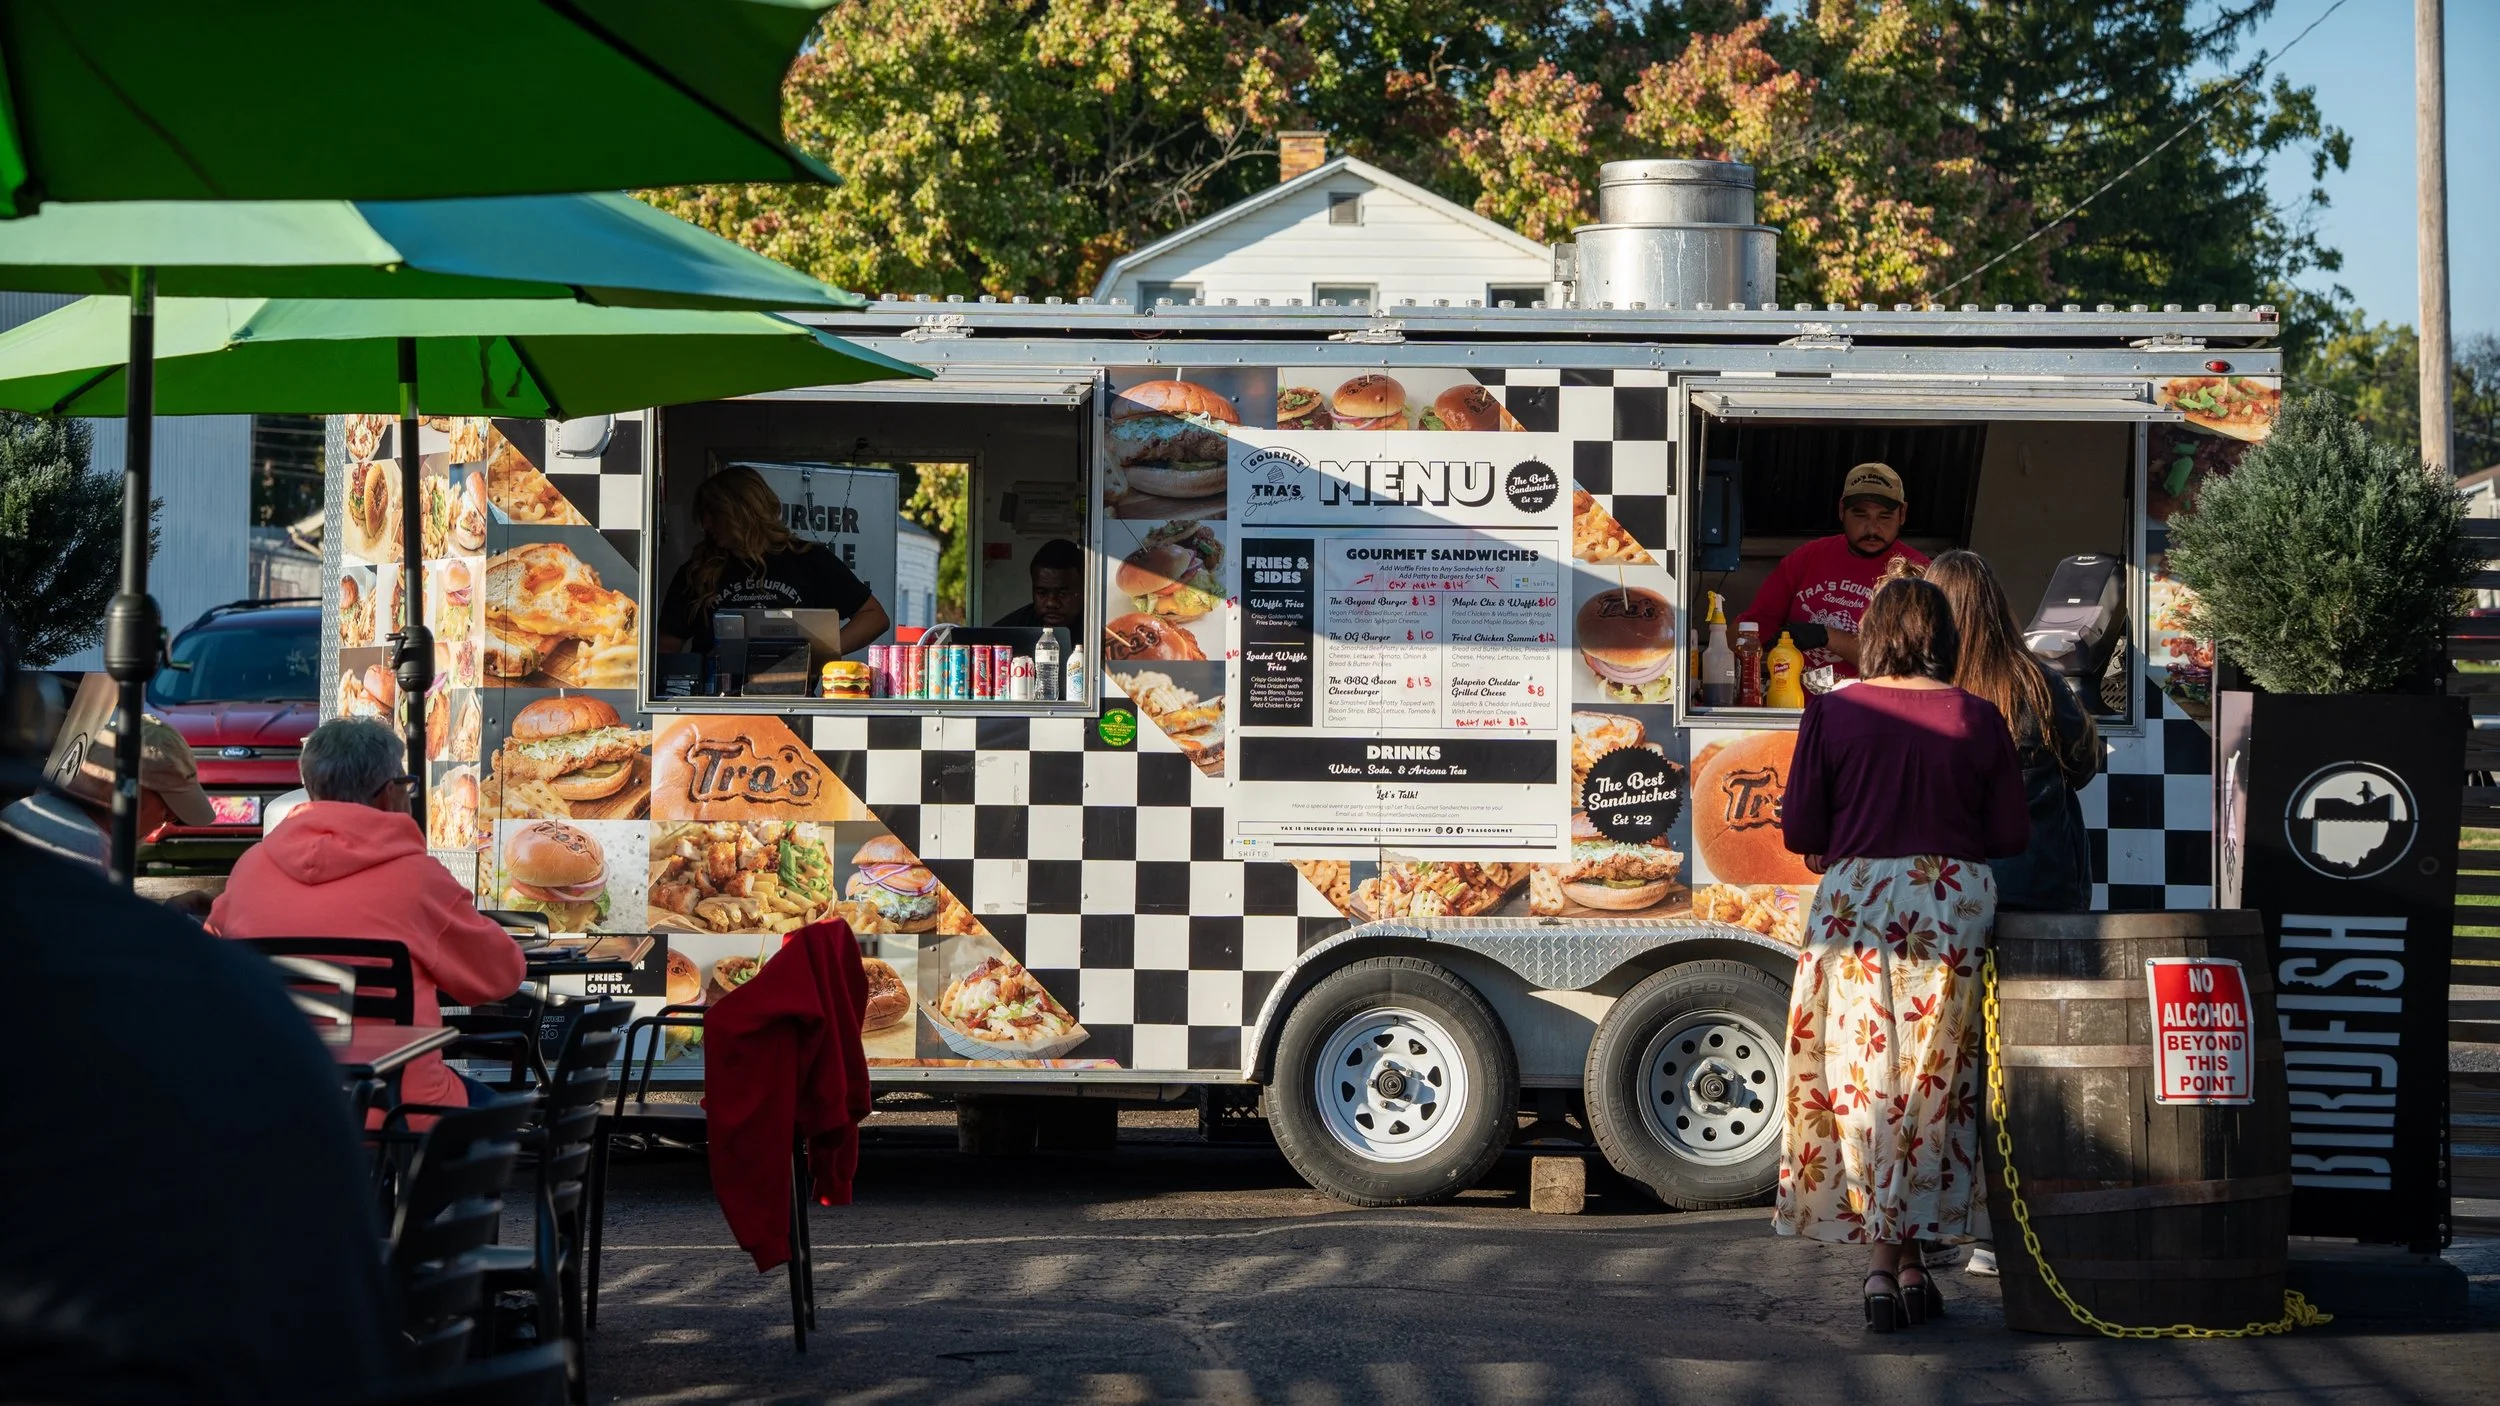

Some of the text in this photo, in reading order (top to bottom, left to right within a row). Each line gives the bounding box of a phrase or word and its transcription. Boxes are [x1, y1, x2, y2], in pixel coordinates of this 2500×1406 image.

[1250, 451, 1304, 467] GOURMET
[1319, 460, 1495, 507] MENU
[1513, 473, 1550, 486] The Best
[1252, 484, 1301, 496] TRA'S
[1509, 482, 1556, 496] Sandwiches
[1346, 549, 1539, 561] GOURMET SANDWICHES
[1247, 557, 1309, 570] FRIES &
[1254, 571, 1301, 583] SIDES
[715, 578, 802, 605] RA'S GOURMET
[1444, 581, 1463, 590] $14
[1796, 579, 1837, 602] TRA'S
[1251, 599, 1304, 609] Waffle Fries
[1329, 596, 1407, 607] The Beyond Burger
[1452, 598, 1477, 608] Maple
[1480, 598, 1496, 607] Chx
[1538, 597, 1556, 607] $10
[1822, 593, 1865, 609] Sandwiches
[1329, 632, 1390, 642] The OG Burger
[1452, 633, 1538, 642] Fried Chicken Sammie
[1226, 650, 1239, 659] $10
[1246, 651, 1308, 663] Loaded Waffle
[1267, 662, 1287, 671] Fries
[1329, 676, 1396, 685] The BBQ Bacon
[1452, 677, 1520, 687] Jalapeño Cheddar
[1329, 687, 1379, 697] Cheeseburger
[1452, 687, 1506, 698] Grilled Cheese
[1528, 685, 1544, 697] $8
[1509, 717, 1528, 727] $12
[225, 748, 245, 756] Ford
[1367, 746, 1441, 760] DRINKS
[693, 743, 812, 797] Tra's
[1398, 766, 1406, 774] &
[1408, 765, 1447, 776] Arizona
[1449, 765, 1467, 775] Teas
[1596, 772, 1665, 794] The Best
[1377, 790, 1418, 800] Let's Talk!
[1588, 787, 1678, 811] Sandwiches
[1612, 814, 1653, 826] Est '22
[588, 973, 623, 981] FRIES
[2188, 968, 2215, 994] NO
[587, 984, 633, 993] OH MY.
[2163, 1002, 2245, 1028] ALCOHOL
[2167, 1034, 2243, 1052] BEYOND
[2276, 914, 2408, 1191] BIRDFISH
[2185, 1055, 2229, 1071] THIS
[2179, 1076, 2236, 1092] POINT
